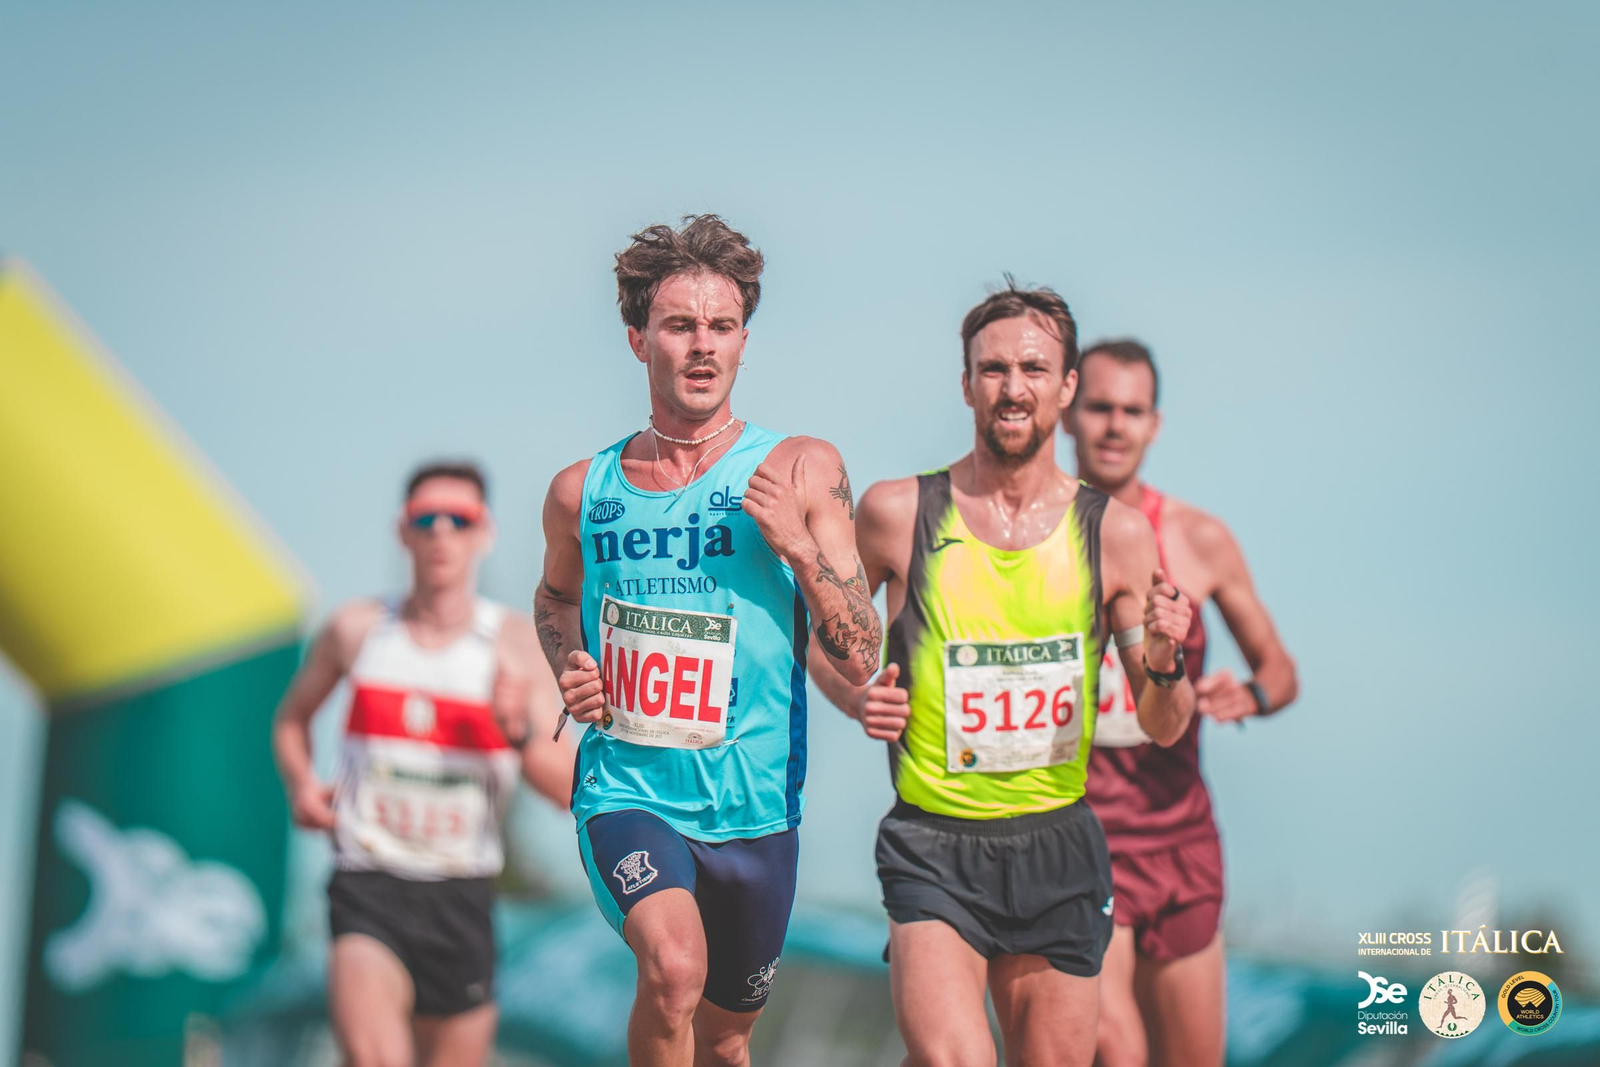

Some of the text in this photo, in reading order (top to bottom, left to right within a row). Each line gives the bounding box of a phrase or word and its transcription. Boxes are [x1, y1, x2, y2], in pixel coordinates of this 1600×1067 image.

[590, 502, 623, 521] TROPS
[592, 512, 735, 571] nerja
[616, 575, 717, 597] ATLETISMO
[626, 611, 693, 634] ITÁLICA
[986, 645, 1051, 663] ITÁLICA
[604, 627, 722, 723] ÁNGEL
[961, 684, 1073, 733] 5126
